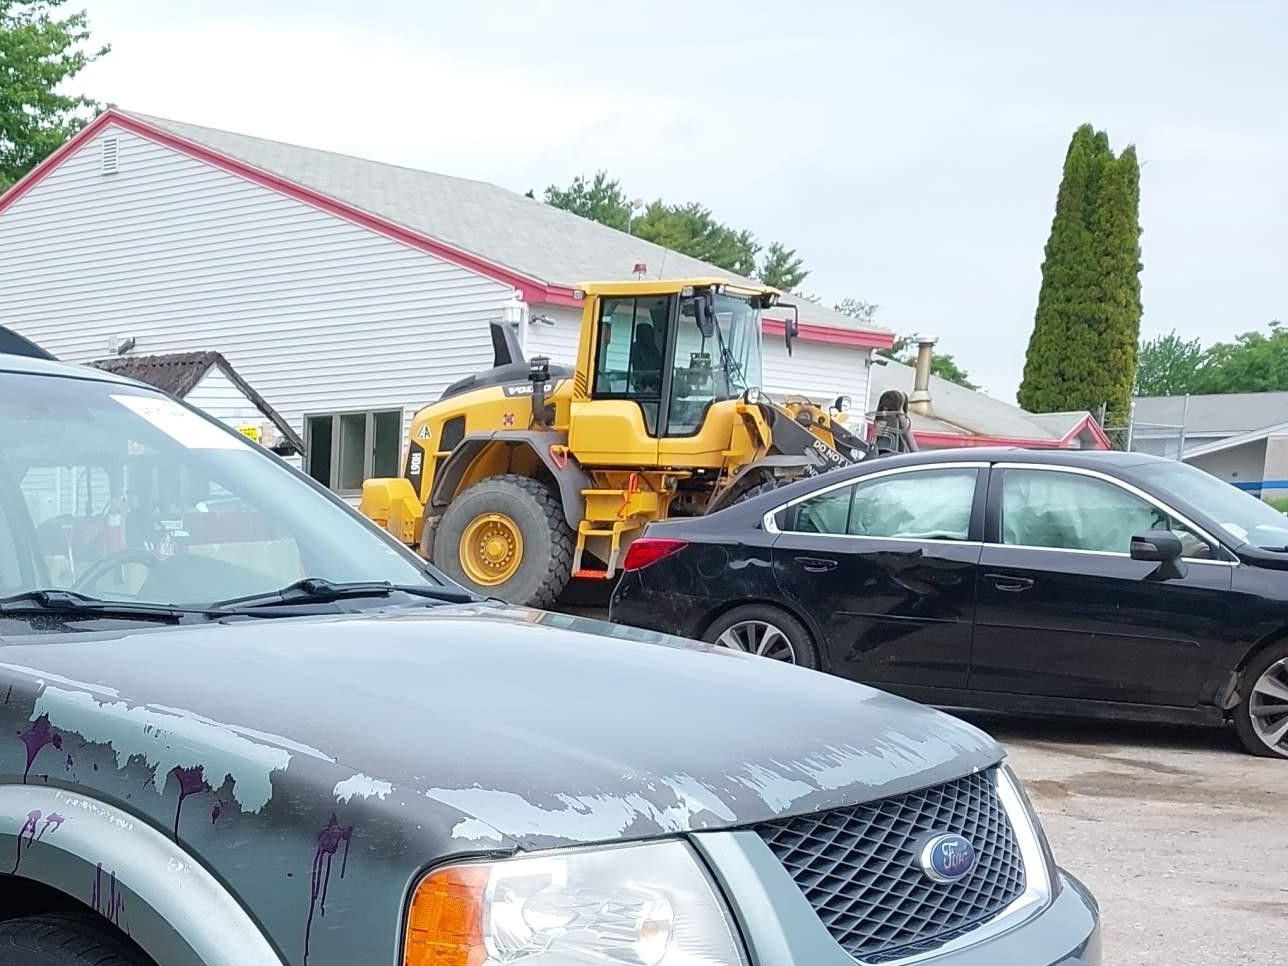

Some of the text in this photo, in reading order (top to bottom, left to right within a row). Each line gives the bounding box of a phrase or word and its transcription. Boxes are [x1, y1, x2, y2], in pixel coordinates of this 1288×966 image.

[508, 384, 552, 395] VOLO
[813, 440, 844, 464] DO NOT
